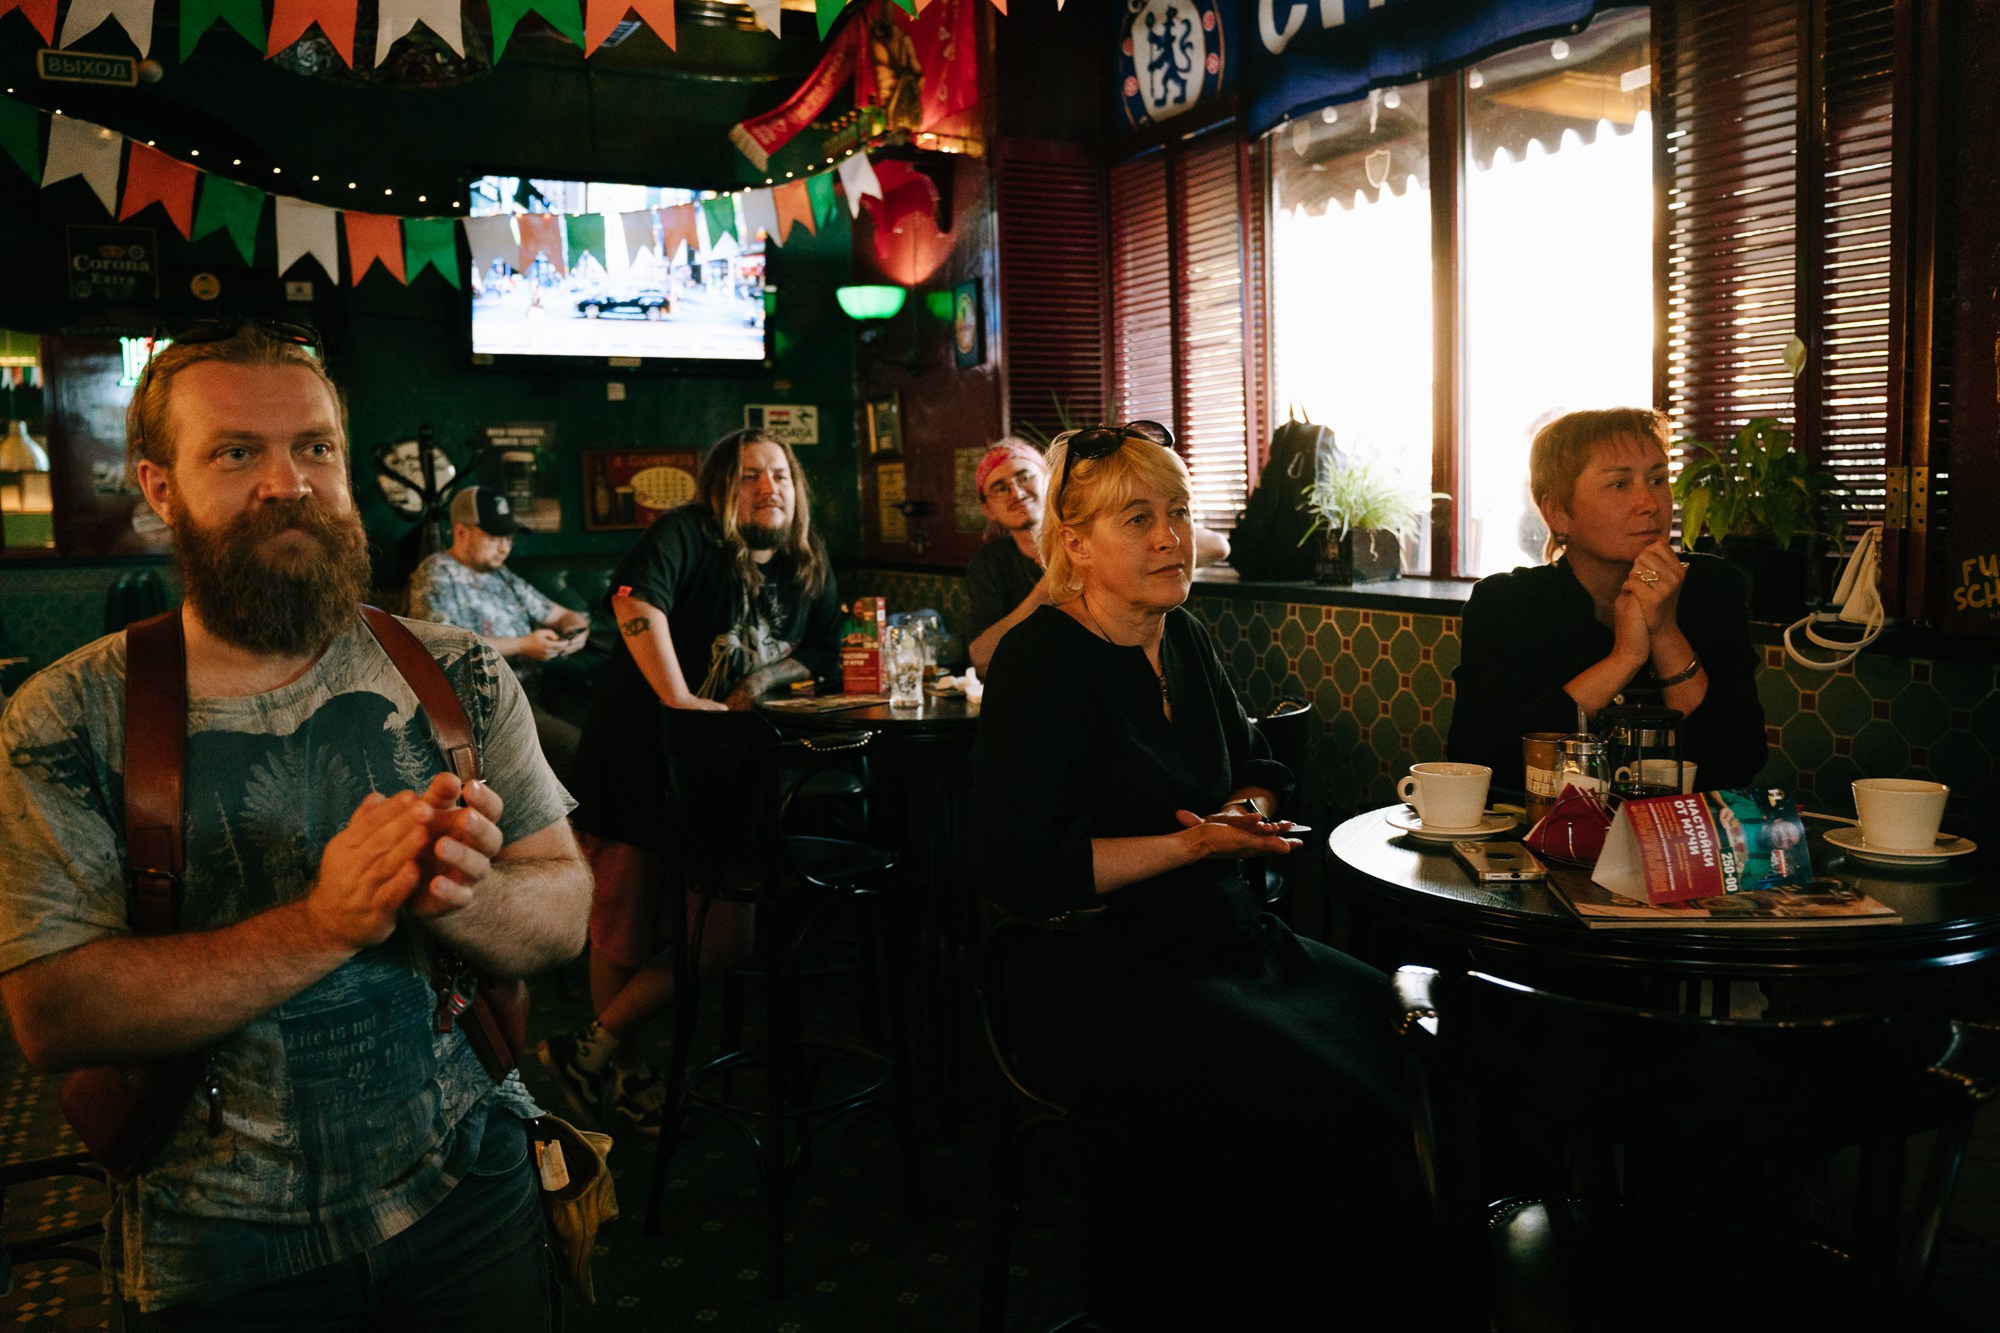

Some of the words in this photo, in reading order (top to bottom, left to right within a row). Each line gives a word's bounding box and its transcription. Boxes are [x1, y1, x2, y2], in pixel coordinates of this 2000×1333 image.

[48, 56, 127, 79] ВЫХОД
[73, 253, 150, 273] Corona
[91, 272, 137, 287] Extra
[1673, 800, 1688, 816] ОТ
[1680, 817, 1700, 856] МУЧИ
[1685, 798, 1715, 868] НАСТОЙКИ
[1721, 851, 1739, 893] 250-00
[330, 1023, 347, 1042] is
[353, 1013, 378, 1036] not
[288, 1035, 377, 1064] measured
